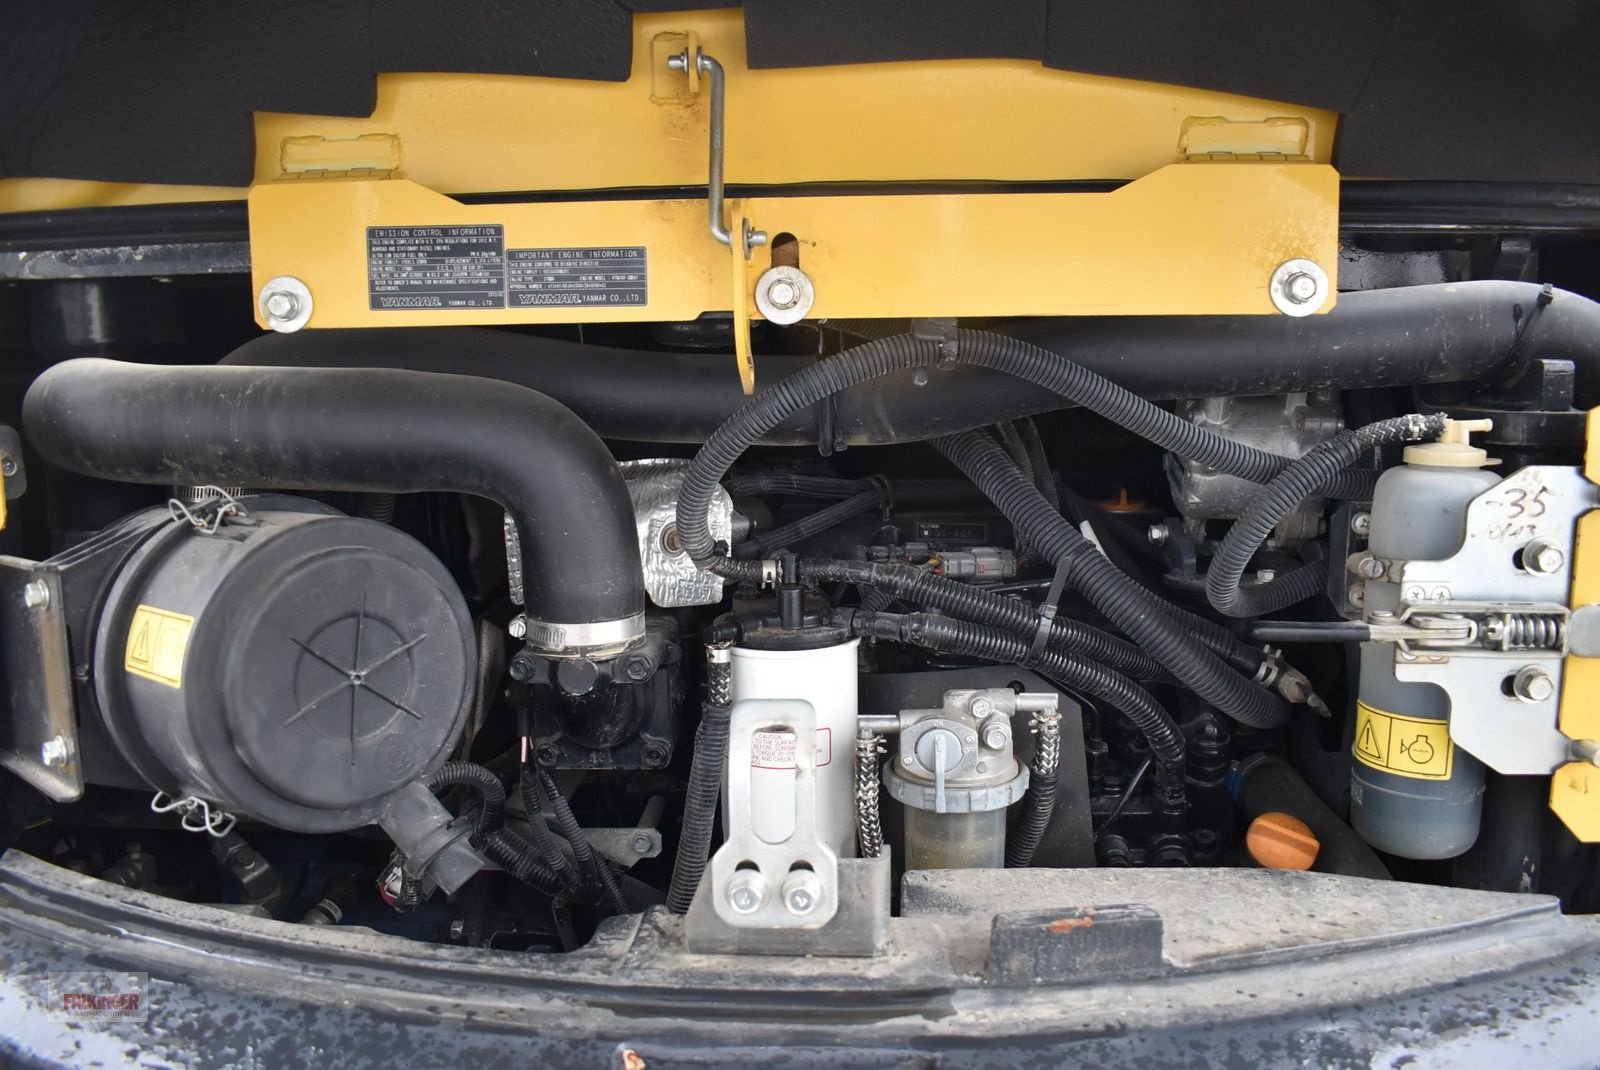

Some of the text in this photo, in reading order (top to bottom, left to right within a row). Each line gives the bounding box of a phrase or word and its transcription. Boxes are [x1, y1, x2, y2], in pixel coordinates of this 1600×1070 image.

[376, 229, 409, 237] EMISSION
[448, 228, 495, 236] INFORMATION
[590, 250, 637, 258] INFORMATION
